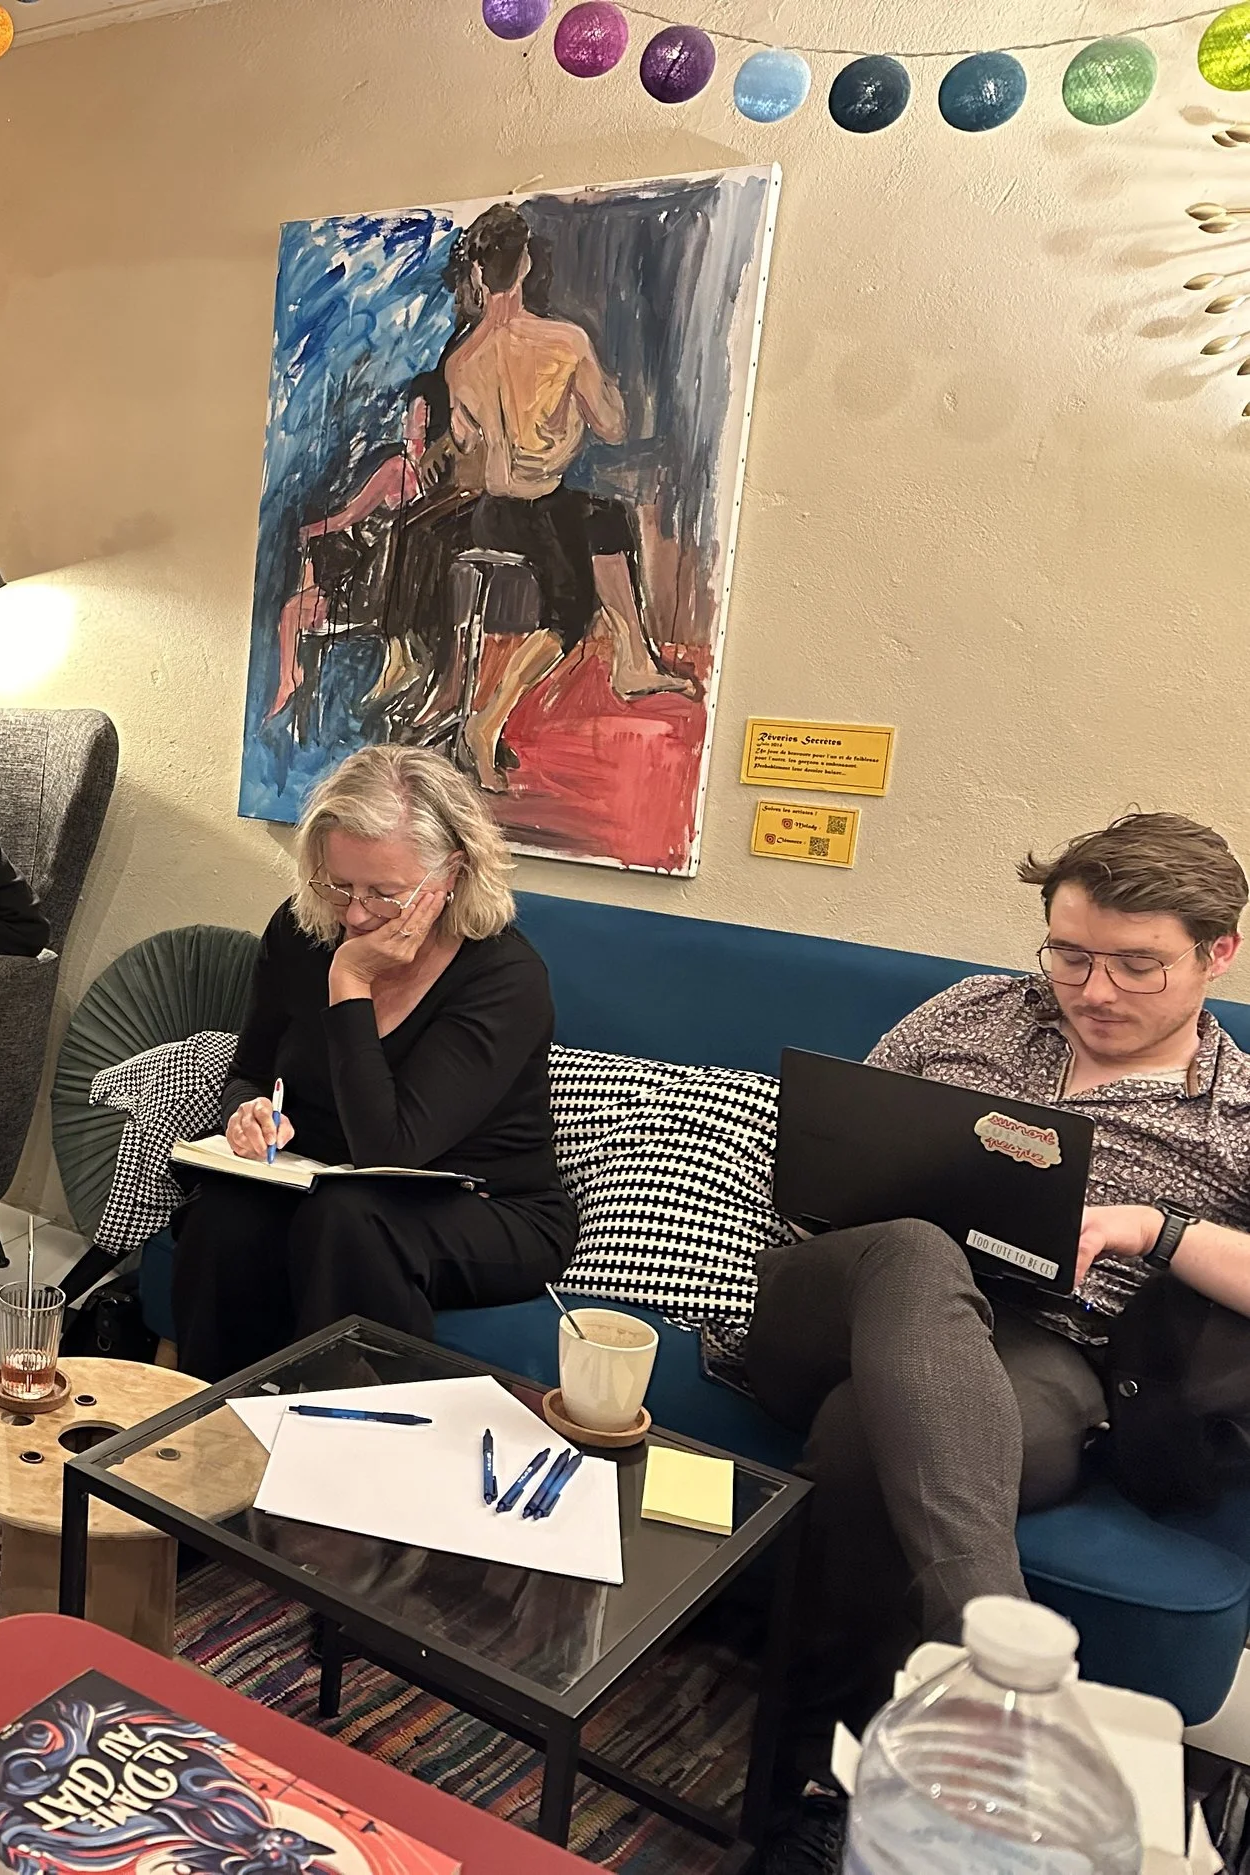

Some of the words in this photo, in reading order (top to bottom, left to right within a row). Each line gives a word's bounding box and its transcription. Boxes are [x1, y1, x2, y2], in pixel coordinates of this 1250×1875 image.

[758, 732, 798, 742] Rêveries
[801, 736, 841, 745] Secrètes
[972, 1233, 989, 1249] TOO
[991, 1242, 1012, 1258] CUTE
[1014, 1252, 1026, 1264] TO
[1028, 1257, 1038, 1270] BE
[1039, 1262, 1054, 1276] CIS
[98, 1723, 146, 1762] AU
[133, 1740, 189, 1764] LA
[23, 1758, 115, 1832] CHAT
[80, 1761, 178, 1832] DAME
